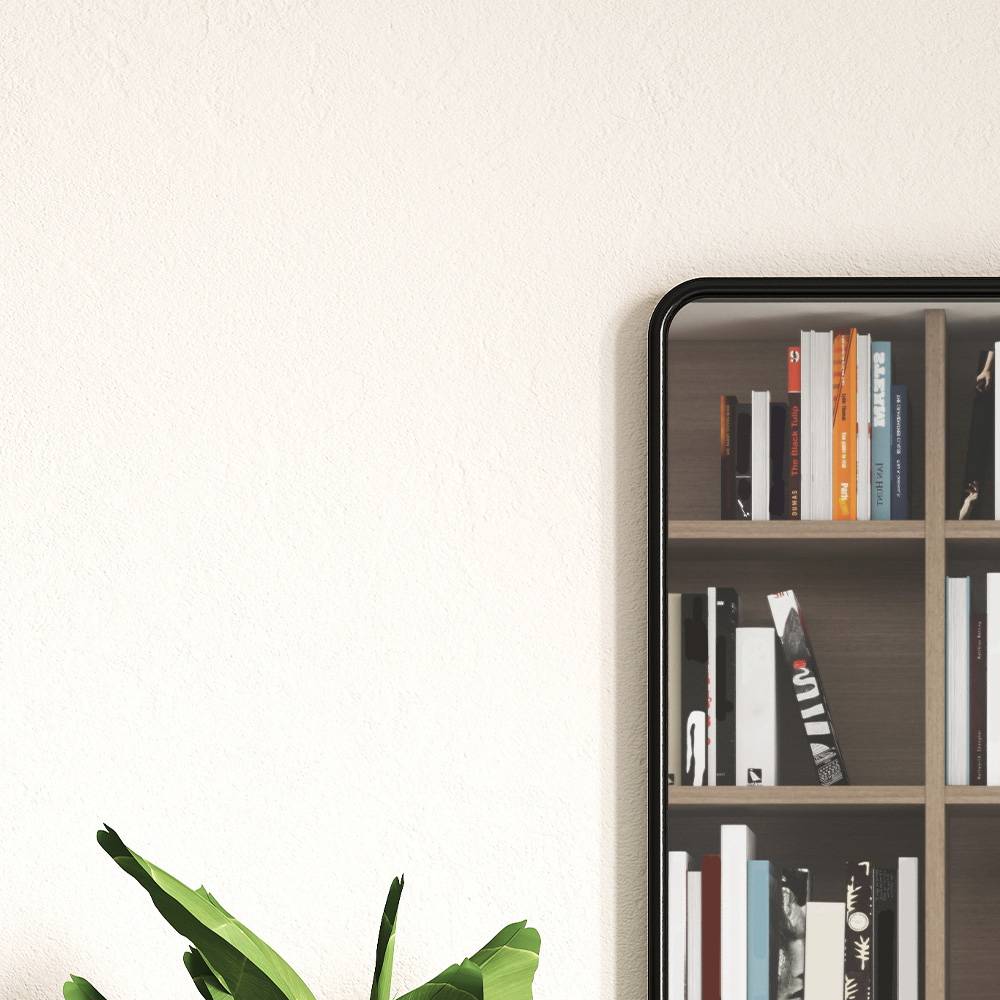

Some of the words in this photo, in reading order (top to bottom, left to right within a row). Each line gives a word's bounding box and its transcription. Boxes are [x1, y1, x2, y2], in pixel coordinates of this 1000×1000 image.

[791, 405, 800, 427] Tulip
[791, 431, 799, 456] Black
[791, 459, 799, 476] The
